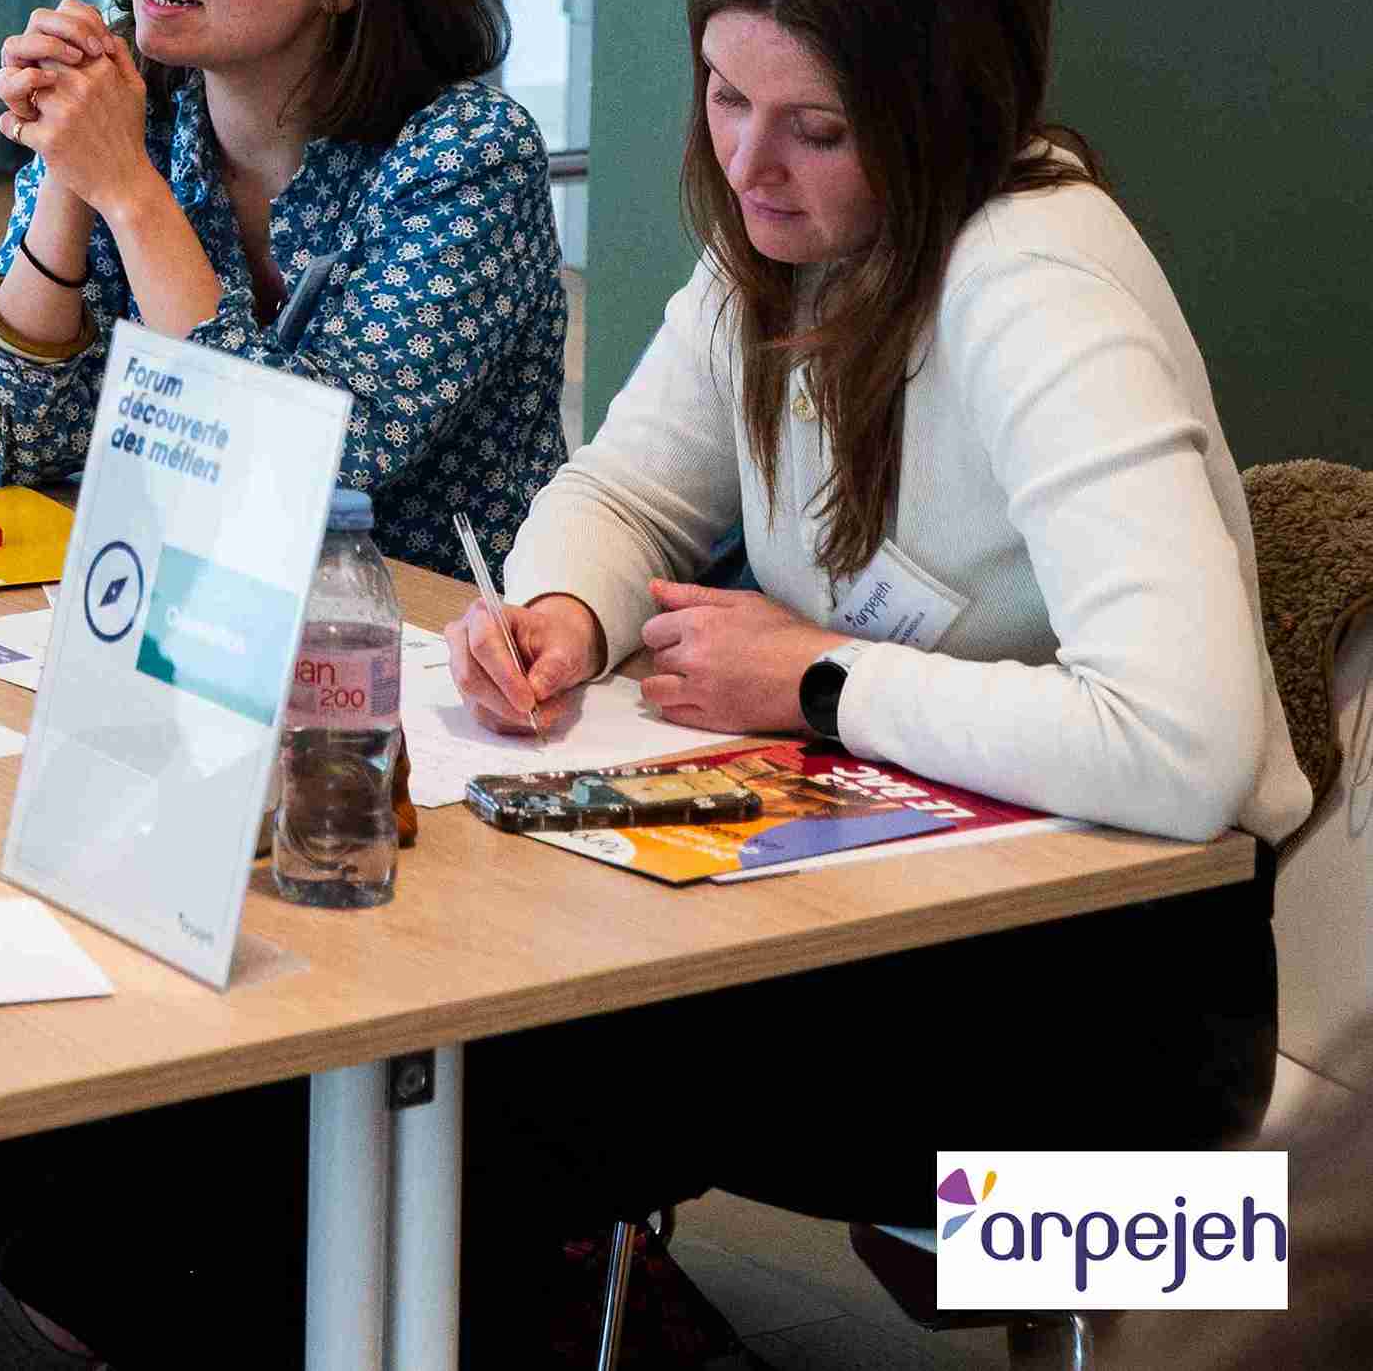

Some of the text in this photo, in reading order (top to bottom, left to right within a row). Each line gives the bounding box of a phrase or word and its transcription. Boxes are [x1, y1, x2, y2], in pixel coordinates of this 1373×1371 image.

[124, 356, 185, 400] Forum
[118, 392, 230, 450] découverte
[111, 424, 222, 483] des métiers
[320, 688, 366, 709] 200
